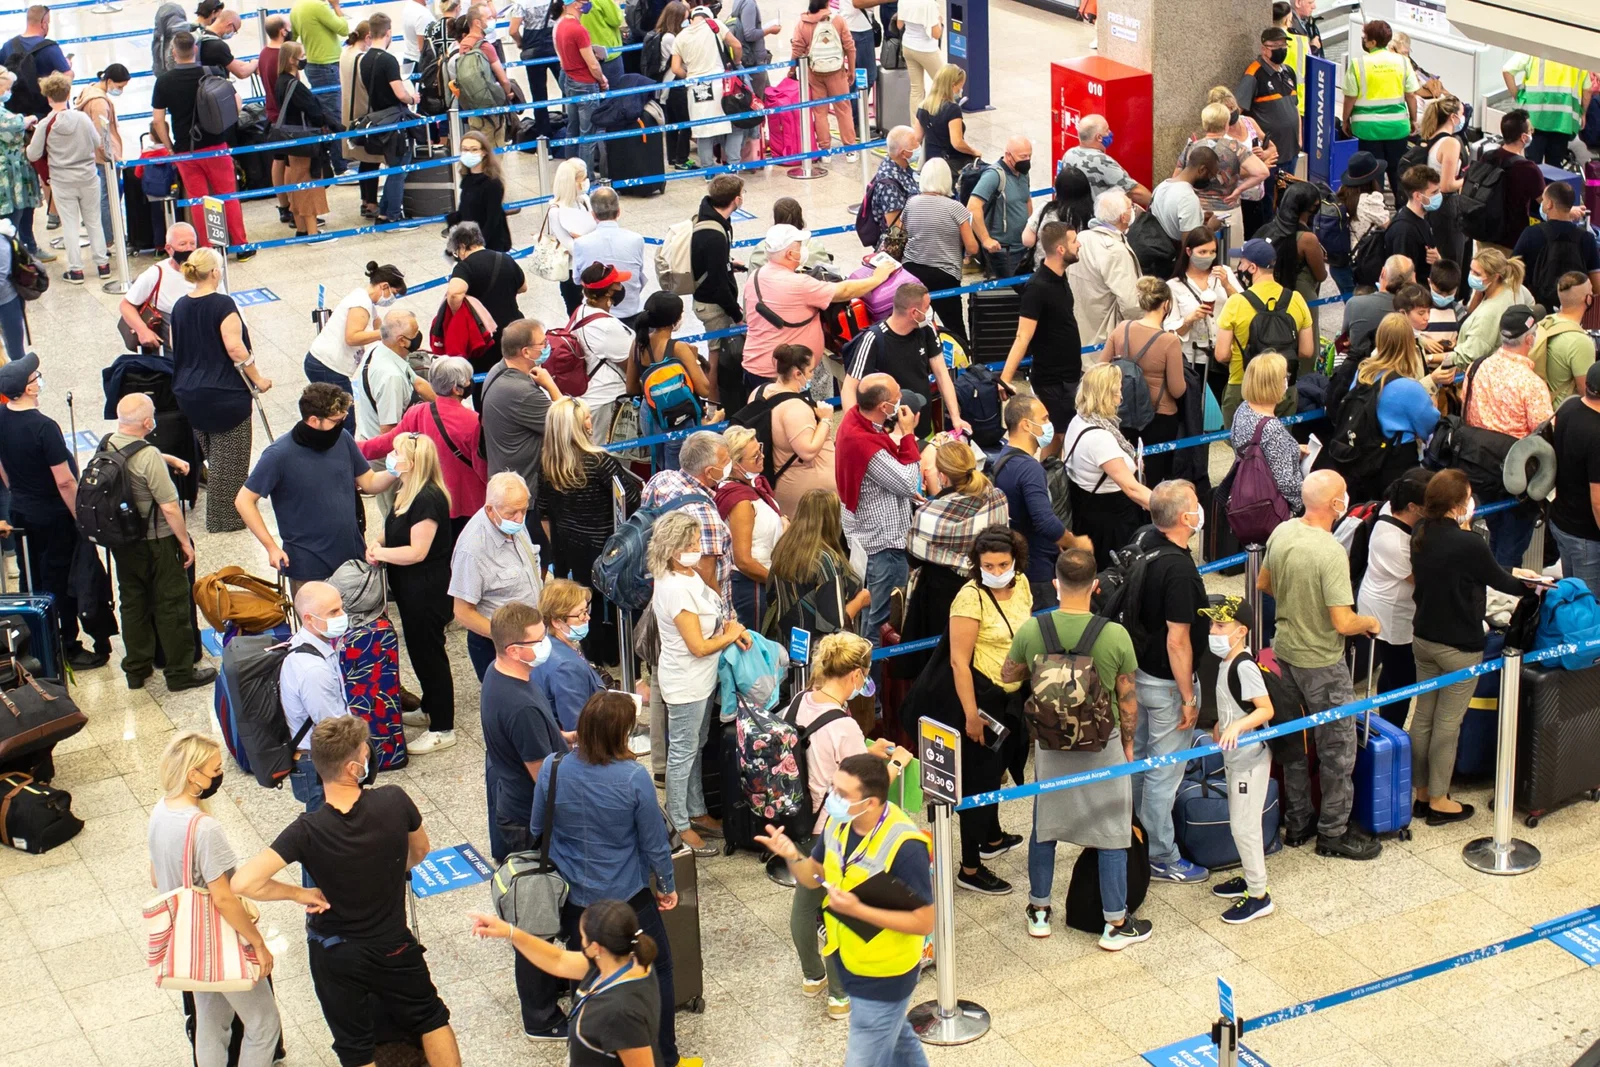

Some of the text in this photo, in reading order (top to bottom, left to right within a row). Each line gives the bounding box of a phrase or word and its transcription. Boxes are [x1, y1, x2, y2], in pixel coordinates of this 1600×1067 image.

[1087, 81, 1103, 97] 010
[1316, 69, 1325, 149] RYANAIR
[212, 214, 221, 225] 22
[211, 227, 220, 238] 23
[889, 646, 904, 654] Malta
[904, 639, 936, 651] International
[1372, 680, 1438, 704] Malta International Airport
[1259, 728, 1279, 739] Airport
[935, 752, 945, 764] 28
[926, 771, 945, 787] 29,30
[1039, 769, 1111, 790] Malta International Airport
[463, 848, 491, 875] WAIT HERE
[422, 859, 438, 872] KEEP
[433, 870, 450, 885] YOUR
[1538, 913, 1596, 938] Let's meet again soon
[1571, 926, 1589, 937] EEP
[1562, 930, 1599, 954] ISTANCE
[1350, 973, 1413, 998] Let's meet again soon
[1178, 1049, 1201, 1066] KEEP
